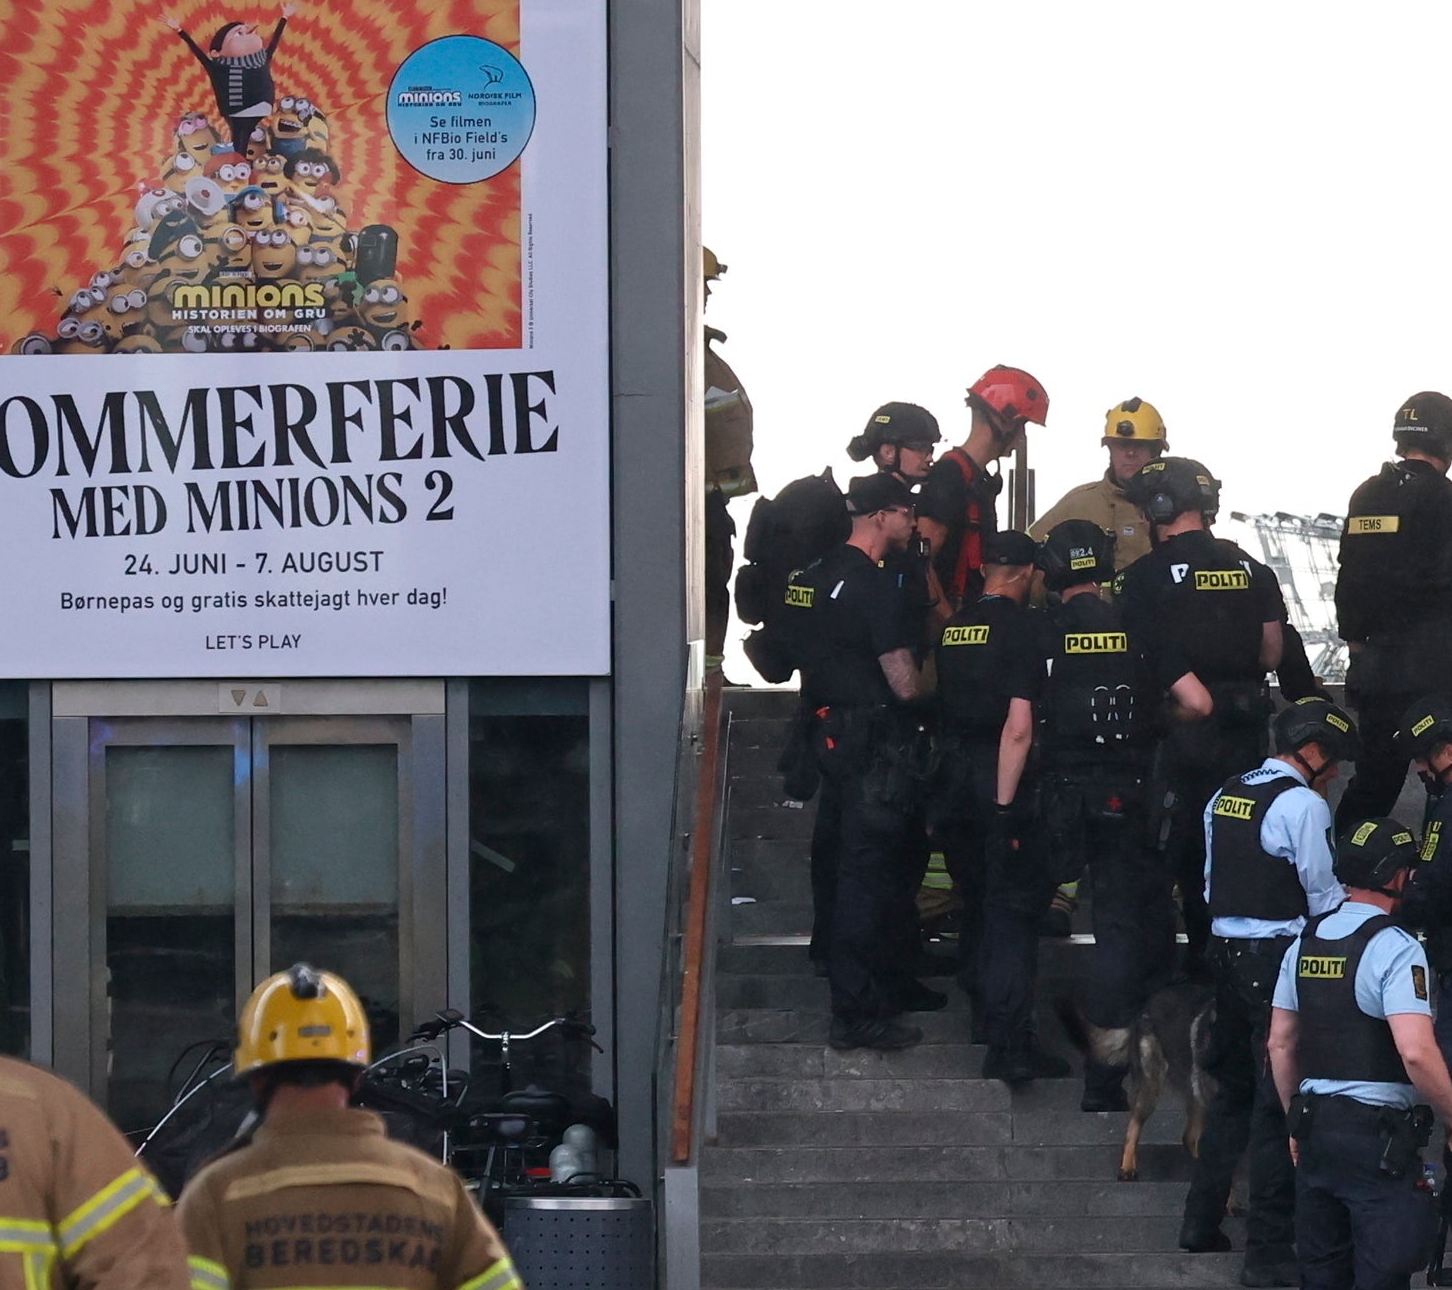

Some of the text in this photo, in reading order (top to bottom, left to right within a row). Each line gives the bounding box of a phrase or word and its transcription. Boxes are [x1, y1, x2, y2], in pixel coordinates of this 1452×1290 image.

[430, 116, 491, 128] Se filmen
[422, 132, 461, 144] NFBio
[466, 131, 507, 143] Field's
[427, 148, 496, 162] fra 30. juni
[172, 309, 326, 320] HISTORIEN OM GRU
[188, 325, 211, 334] SKAL
[213, 325, 251, 333] OPLEVES
[259, 324, 311, 333] BIOGRAFEN
[1403, 409, 1418, 421] TL
[50, 470, 456, 540] MED MINIONS 2
[1359, 519, 1381, 530] TEMS
[123, 554, 160, 576] 24.
[168, 553, 227, 576] JUNI
[255, 553, 273, 575] 7.
[281, 551, 384, 574] AUGUST
[1197, 572, 1246, 586] POLITI
[60, 588, 448, 613] Børnepas og gratis skattejagt hver dag!
[787, 588, 813, 605] POLITI
[205, 633, 302, 651] LET'S PLAY
[943, 628, 987, 643] POLITI
[1067, 635, 1125, 650] POLITI
[1413, 716, 1434, 734] POLITI
[1300, 960, 1345, 975] POLITI
